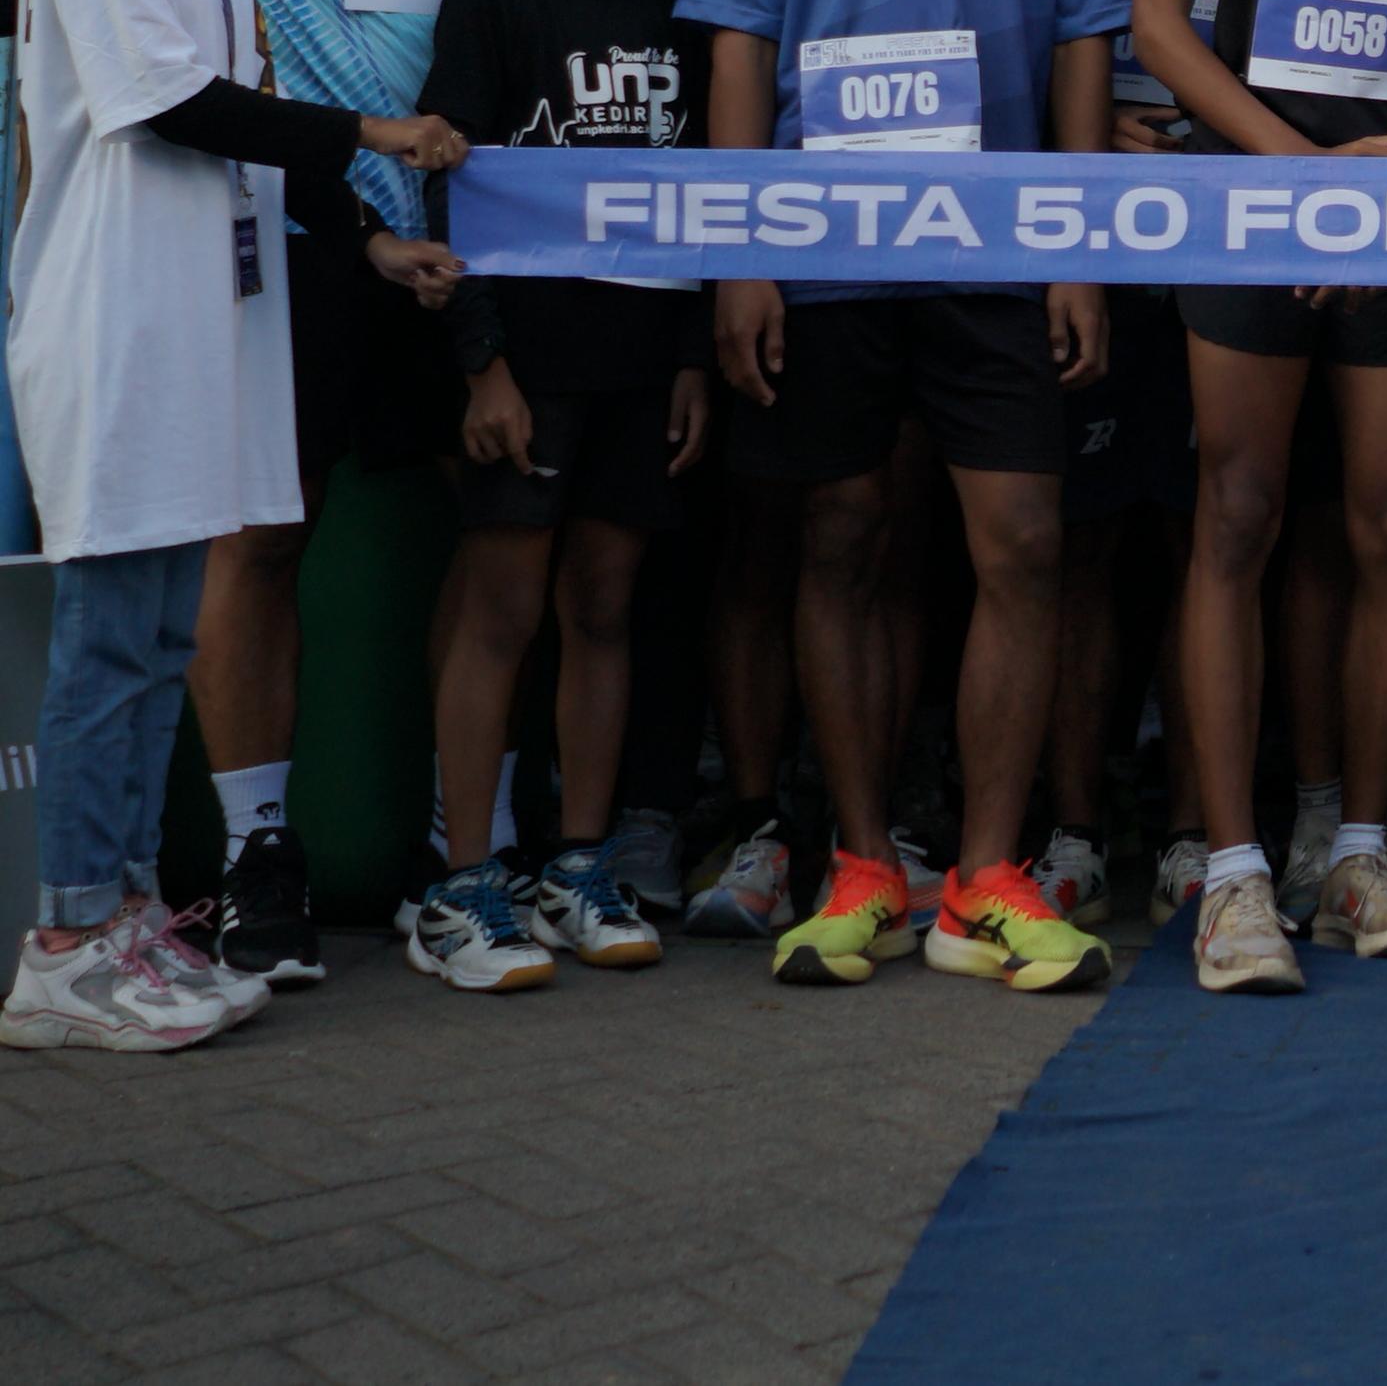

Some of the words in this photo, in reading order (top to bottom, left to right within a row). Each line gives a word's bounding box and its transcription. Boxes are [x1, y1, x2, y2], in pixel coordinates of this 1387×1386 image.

[841, 71, 940, 121] 0076
[585, 181, 983, 248] FIESTA
[1014, 186, 1189, 251] 5.0
